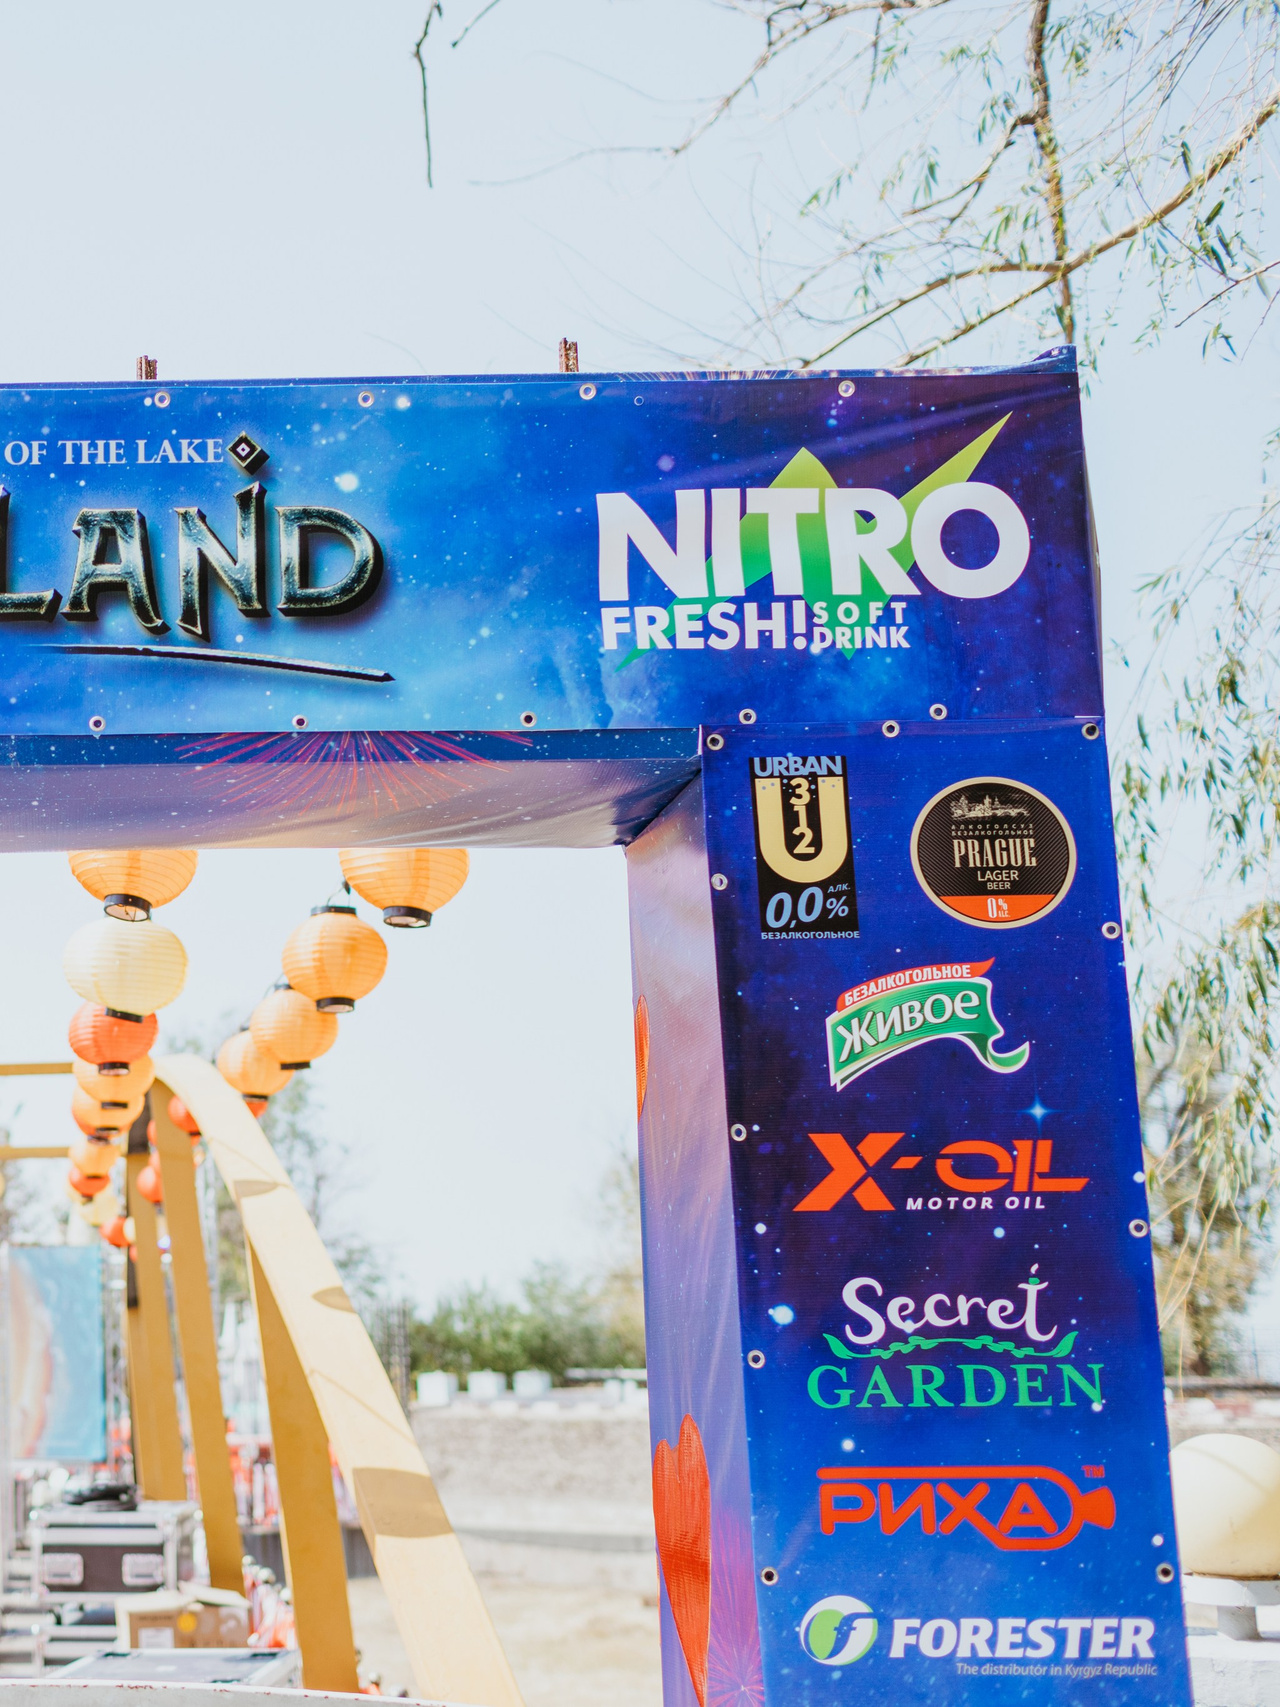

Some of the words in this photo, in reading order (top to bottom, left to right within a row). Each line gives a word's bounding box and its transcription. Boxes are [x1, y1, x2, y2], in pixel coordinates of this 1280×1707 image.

[4, 440, 47, 465] OF
[57, 439, 126, 465] THE
[135, 438, 224, 464] LAKE
[596, 482, 1030, 601] NITRO
[600, 601, 807, 650] FRESH!
[812, 601, 907, 625] SOFT
[814, 626, 911, 648] DRINK
[754, 756, 842, 777] URBAN
[952, 838, 1037, 867] PRAGUE
[977, 870, 1019, 881] LAGER
[987, 882, 1011, 890] BEER
[761, 930, 860, 940] БЕЗАЛКОГОЛЬНОЕ
[844, 964, 971, 1006] БЕЗАЛКОГОЛЬНОЕ
[792, 1132, 1090, 1212] X-OIL
[906, 1197, 994, 1210] MOTOR
[1005, 1196, 1046, 1210] OIL
[841, 1272, 1058, 1345] Secret
[807, 1364, 1105, 1409] GARDEN
[819, 1481, 1065, 1551] РИХА
[889, 1618, 1155, 1658] FORESTER
[956, 1663, 978, 1675] The
[981, 1663, 1047, 1676] distributor
[1050, 1664, 1062, 1675] in
[1065, 1665, 1102, 1678] Kyrgyz
[1104, 1664, 1157, 1676] Republic
